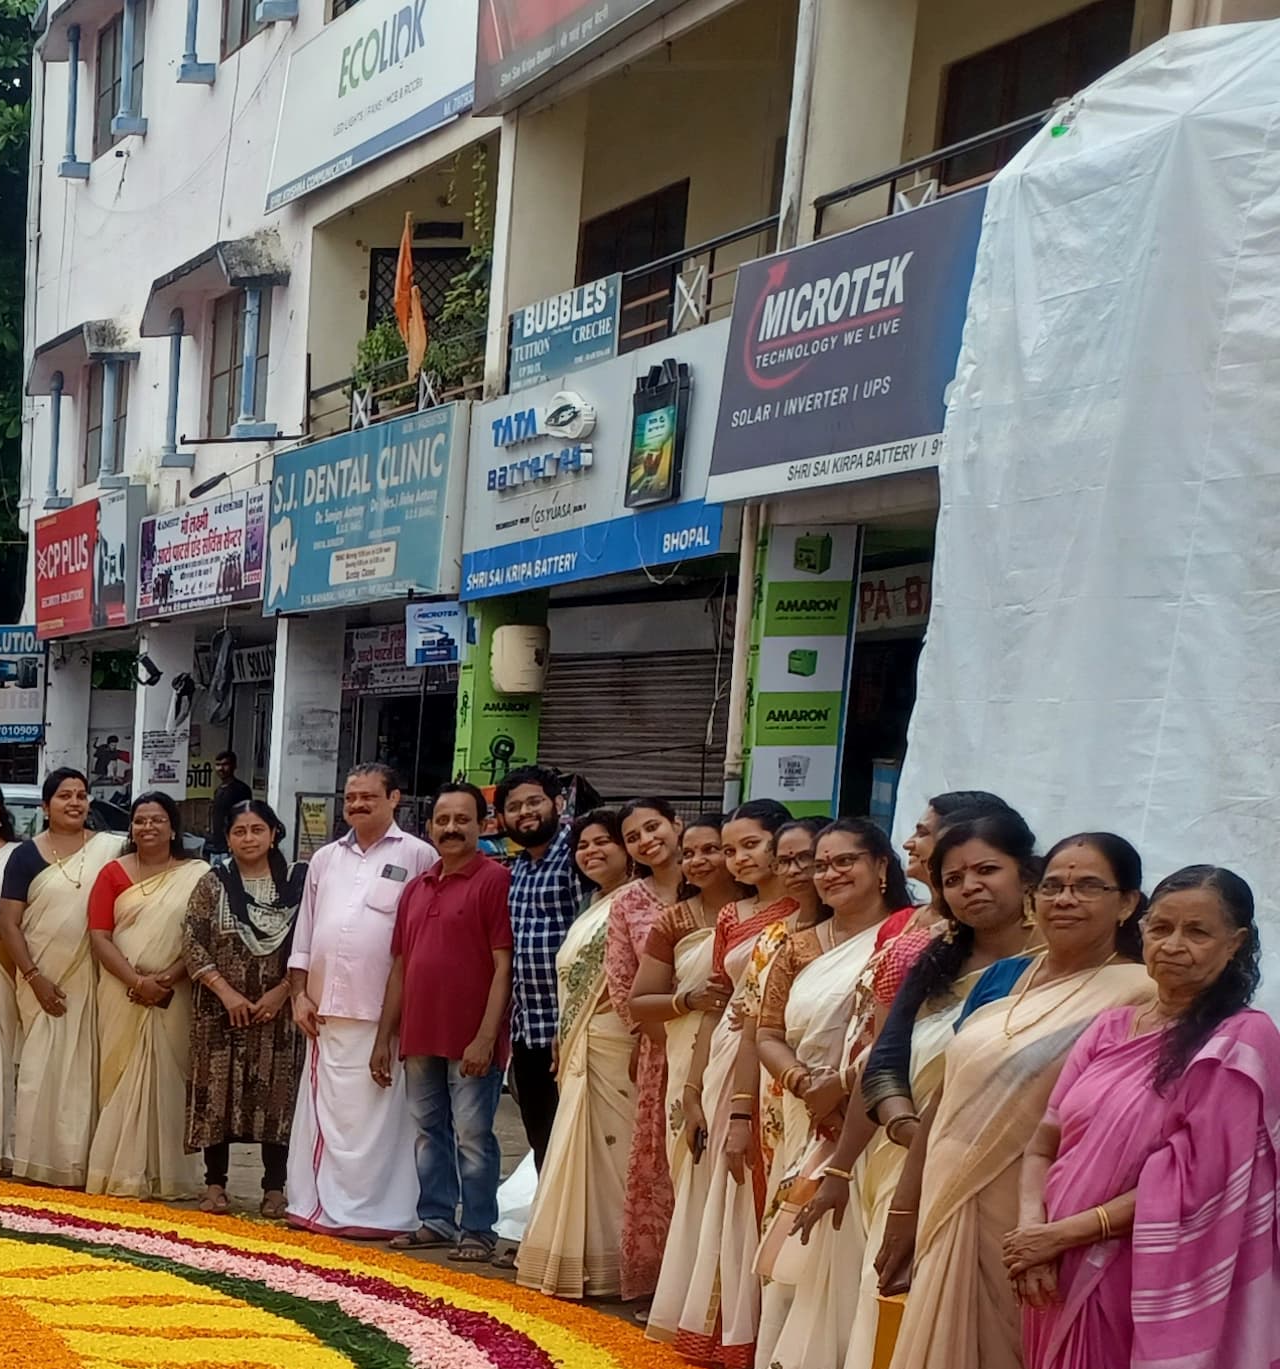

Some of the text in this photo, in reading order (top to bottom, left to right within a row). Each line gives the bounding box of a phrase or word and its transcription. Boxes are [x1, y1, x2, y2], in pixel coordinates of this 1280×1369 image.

[523, 279, 607, 338] BUBBLES
[758, 251, 914, 342] MICROTEK
[572, 316, 614, 345] CRECHE
[755, 317, 901, 369] TECHNOLOGY WE LIVE
[731, 376, 892, 428] SOLAR INVERTER UPS
[492, 407, 537, 448] TATA
[273, 472, 298, 515] S.J.
[302, 453, 372, 507] DENTAL
[376, 432, 446, 490] CLINIC
[786, 442, 918, 481] SHRI SAI KIRPA BATTERY
[46, 532, 90, 580] CP PLUS
[662, 525, 711, 554] BHOPAL
[466, 551, 578, 592] SHRI SAI KRIPA BATTERY
[415, 609, 460, 620] MICROTEK
[775, 598, 840, 613] AMARON
[482, 702, 531, 712] AMARON
[765, 708, 831, 723] AMARON
